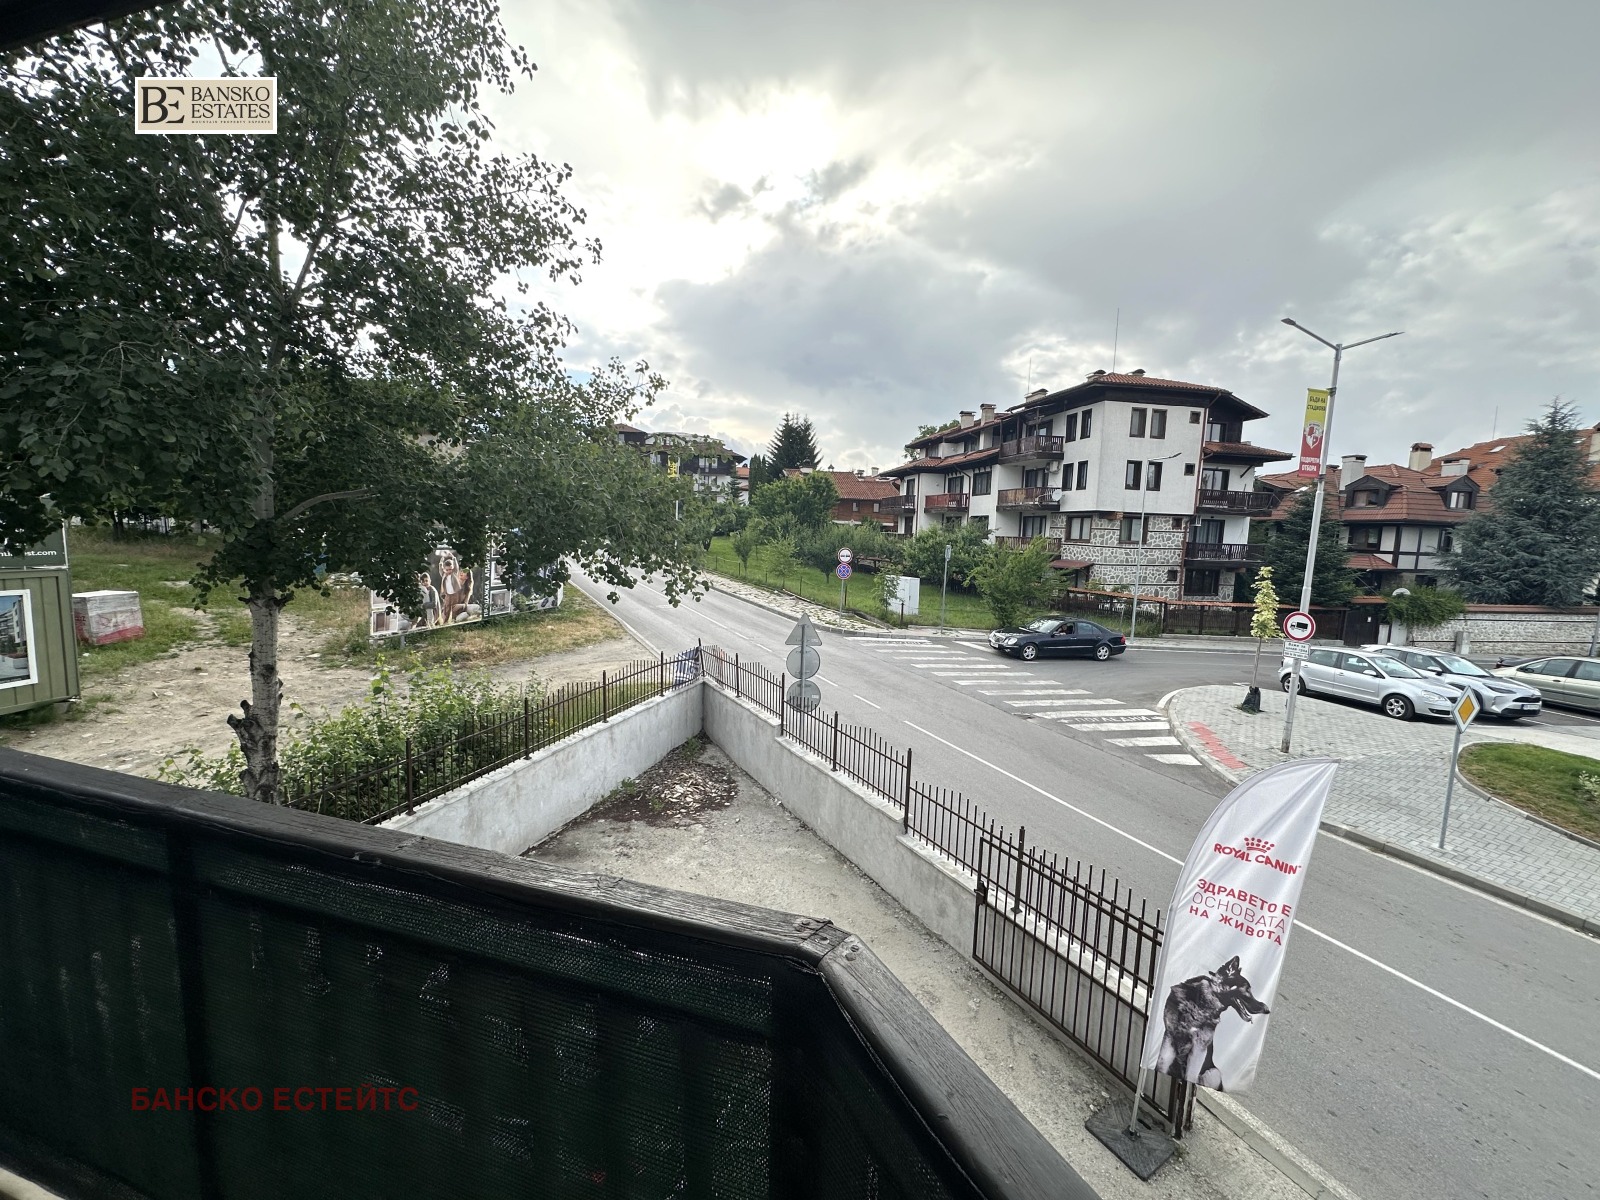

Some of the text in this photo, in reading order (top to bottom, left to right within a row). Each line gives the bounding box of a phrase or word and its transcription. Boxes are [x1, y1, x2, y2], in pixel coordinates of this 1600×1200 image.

[1214, 843, 1298, 875] ROYAL CANIN
[1192, 891, 1285, 933] ОСНОВАТА
[1197, 879, 1292, 917] ЗДРАВЕТО Е
[1189, 905, 1282, 946] НА ЖИВОТА
